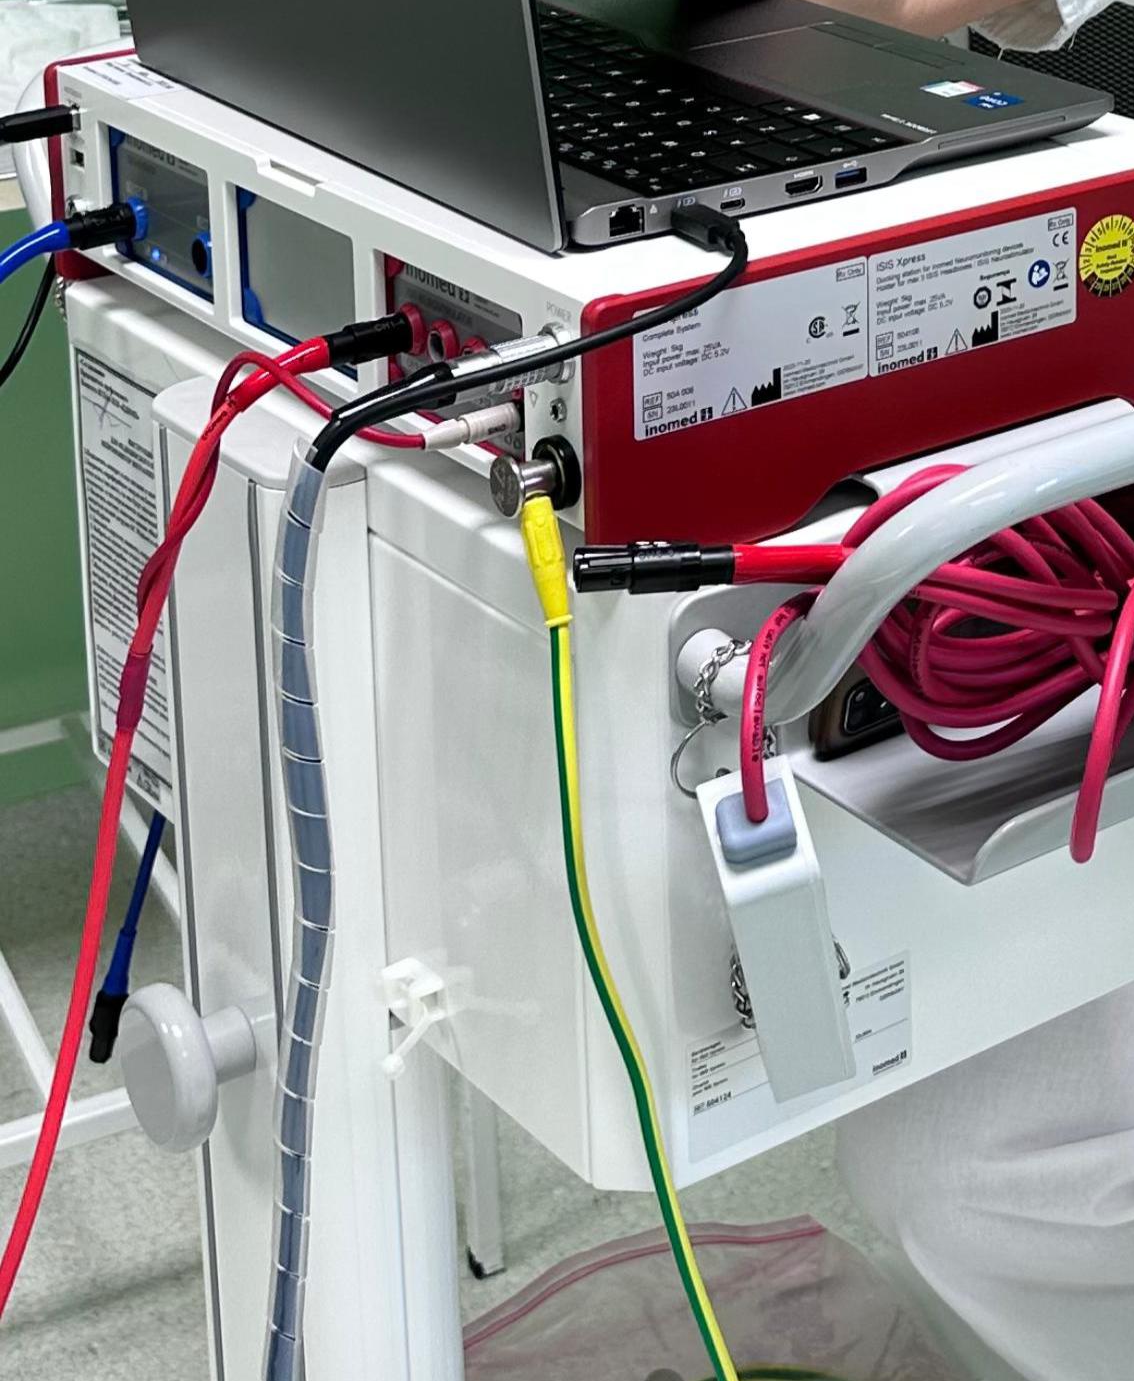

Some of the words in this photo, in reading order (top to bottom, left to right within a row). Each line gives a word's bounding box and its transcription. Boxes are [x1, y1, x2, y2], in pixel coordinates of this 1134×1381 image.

[896, 253, 926, 269] Xpress
[877, 349, 924, 374] inomed
[645, 410, 698, 437] inomed
